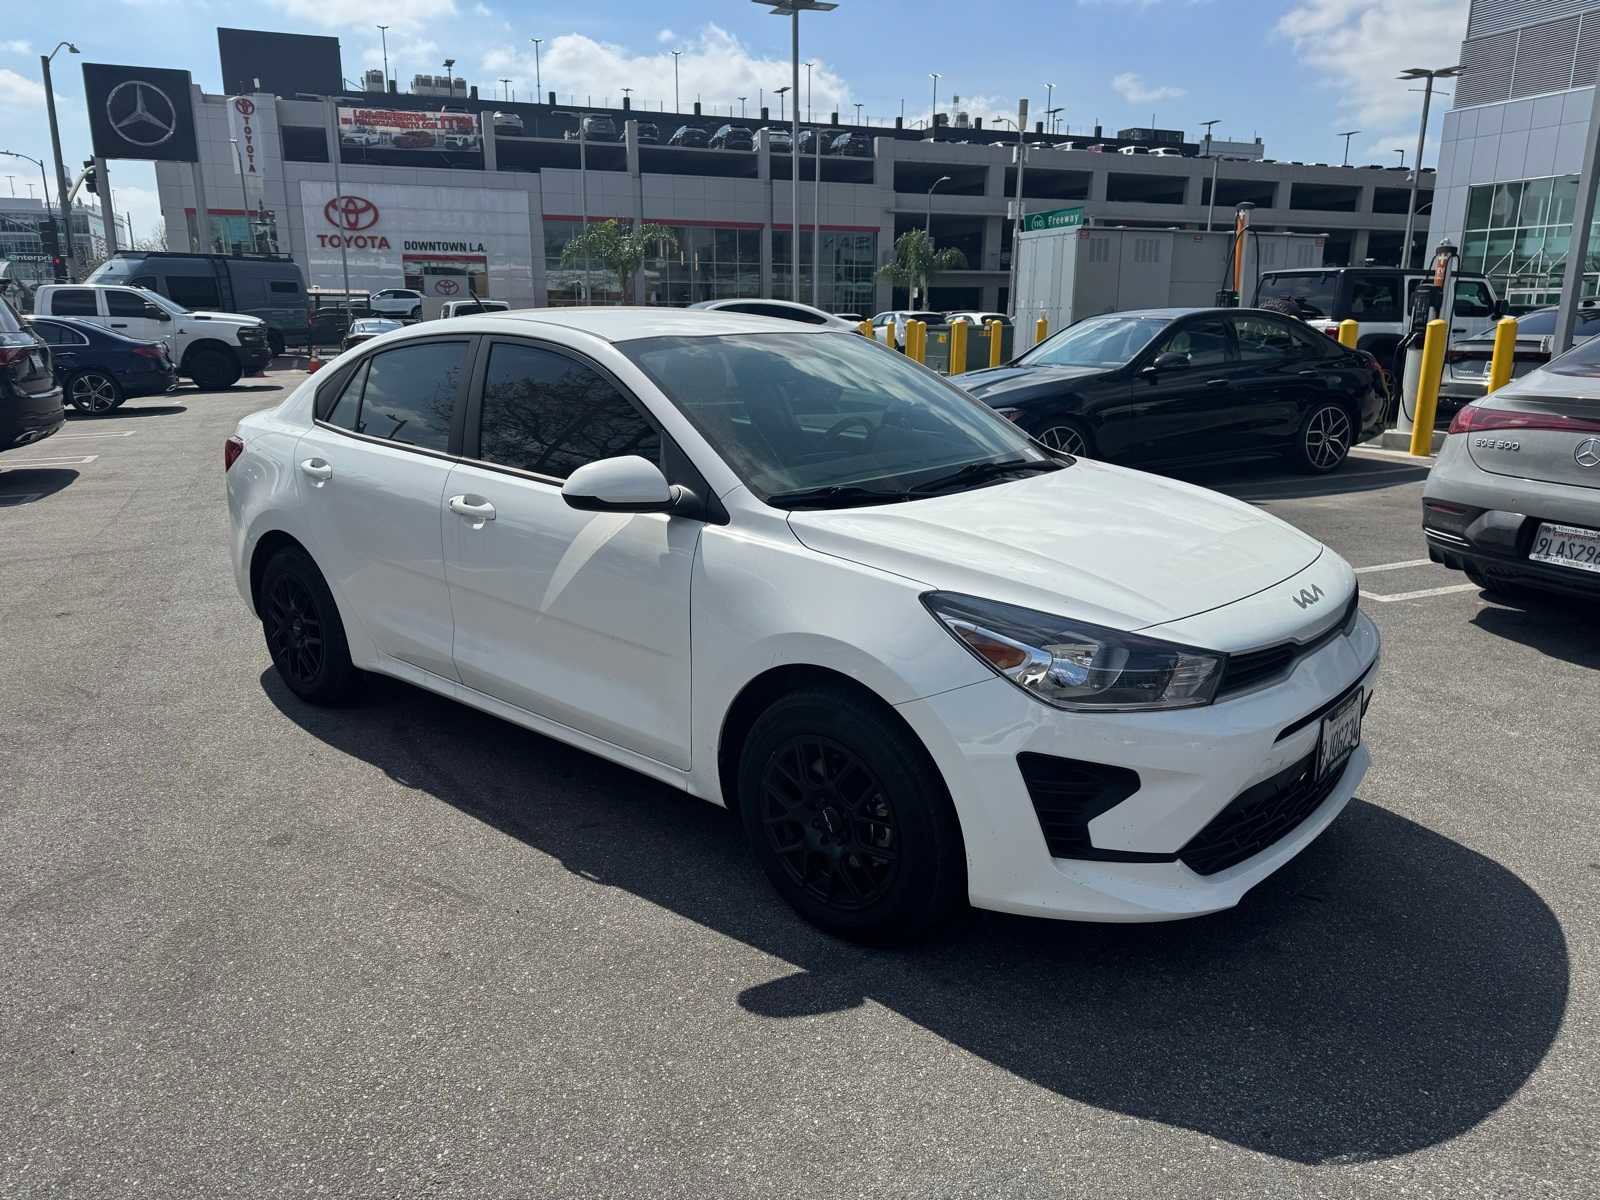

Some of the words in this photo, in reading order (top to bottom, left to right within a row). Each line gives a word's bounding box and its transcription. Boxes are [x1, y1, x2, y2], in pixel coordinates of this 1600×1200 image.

[243, 116, 256, 173] TOYOTA
[1048, 215, 1079, 225] Freeway
[316, 234, 391, 249] TOYOTA
[404, 240, 467, 251] DOWNTOWN
[469, 243, 487, 252] L.A.
[9, 254, 52, 262] enterpri
[1496, 440, 1519, 451] 500
